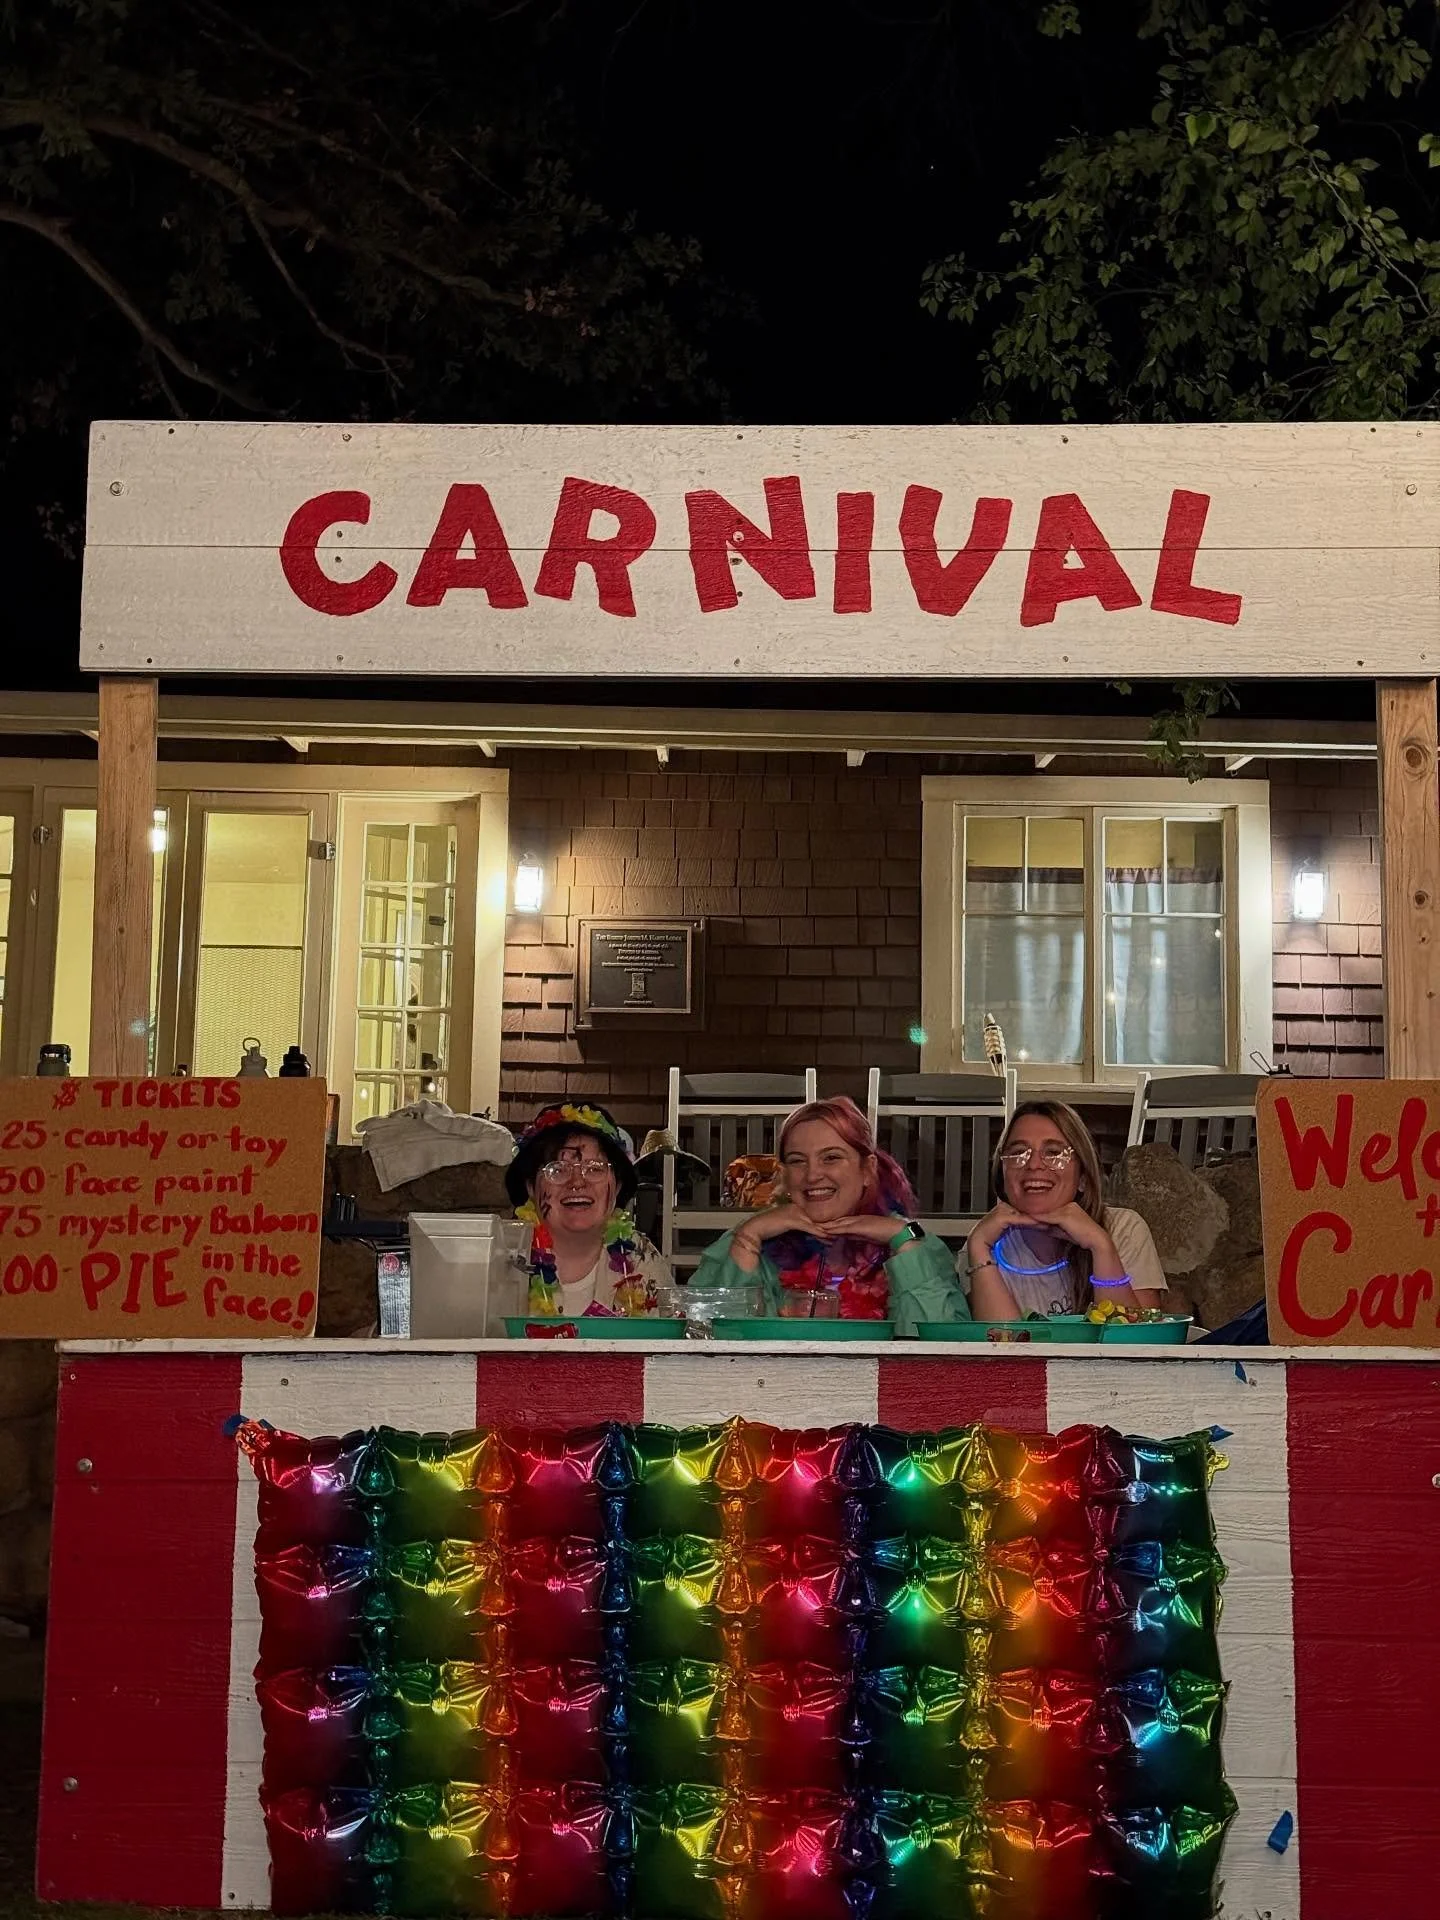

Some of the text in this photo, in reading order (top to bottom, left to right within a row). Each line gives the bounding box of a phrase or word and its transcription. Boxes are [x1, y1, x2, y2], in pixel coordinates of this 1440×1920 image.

[279, 475, 1243, 628] CARNIVAL
[93, 1079, 241, 1109] TICKETS
[177, 1131, 219, 1150] or
[224, 1125, 288, 1167] toy
[65, 1162, 143, 1196] face
[155, 1164, 260, 1206] paint
[59, 1203, 202, 1249] mystery
[0, 1253, 58, 1294] 00
[80, 1248, 188, 1314] PIE
[202, 1243, 301, 1278] in the
[1278, 1211, 1440, 1338] Car
[204, 1276, 315, 1331] face!
